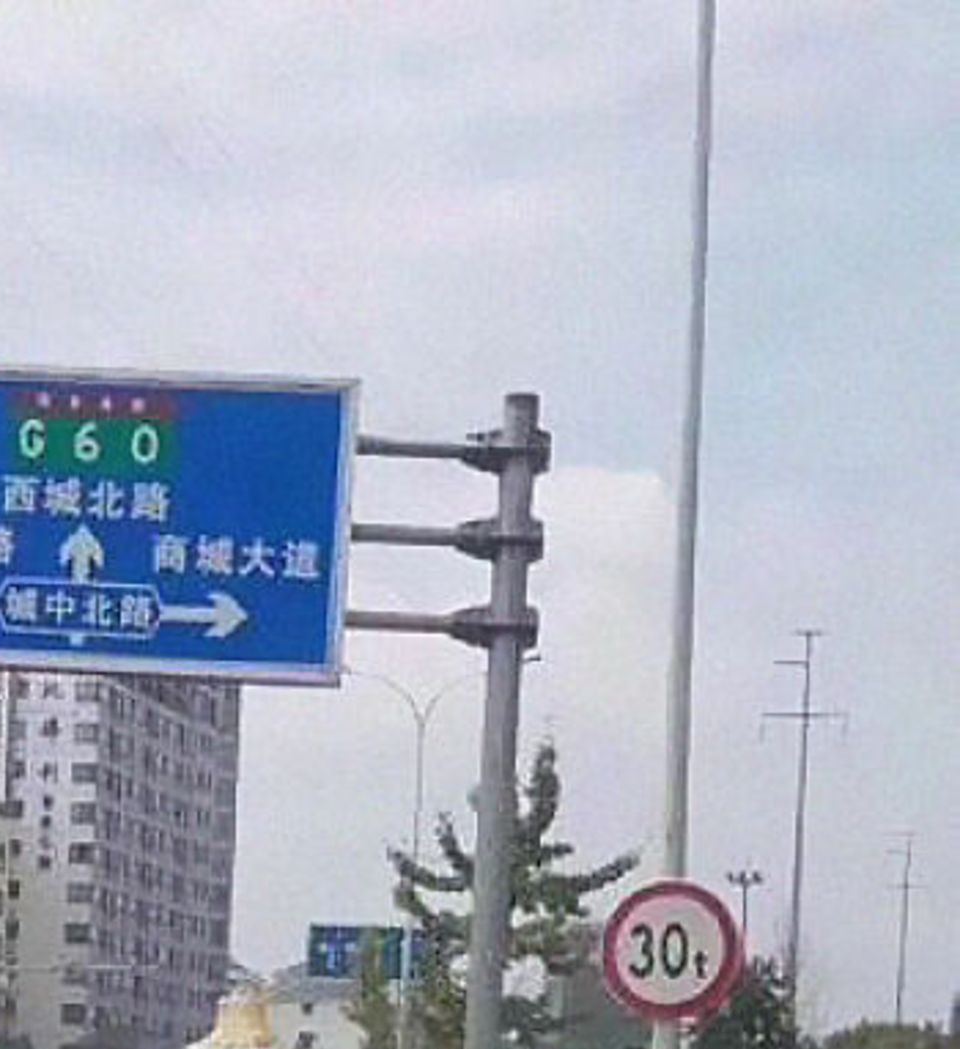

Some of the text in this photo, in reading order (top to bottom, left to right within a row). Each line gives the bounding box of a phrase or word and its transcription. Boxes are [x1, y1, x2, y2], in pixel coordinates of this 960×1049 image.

[19, 418, 159, 465] G60
[3, 475, 171, 522] 西城北路
[153, 534, 321, 578] 商城大道
